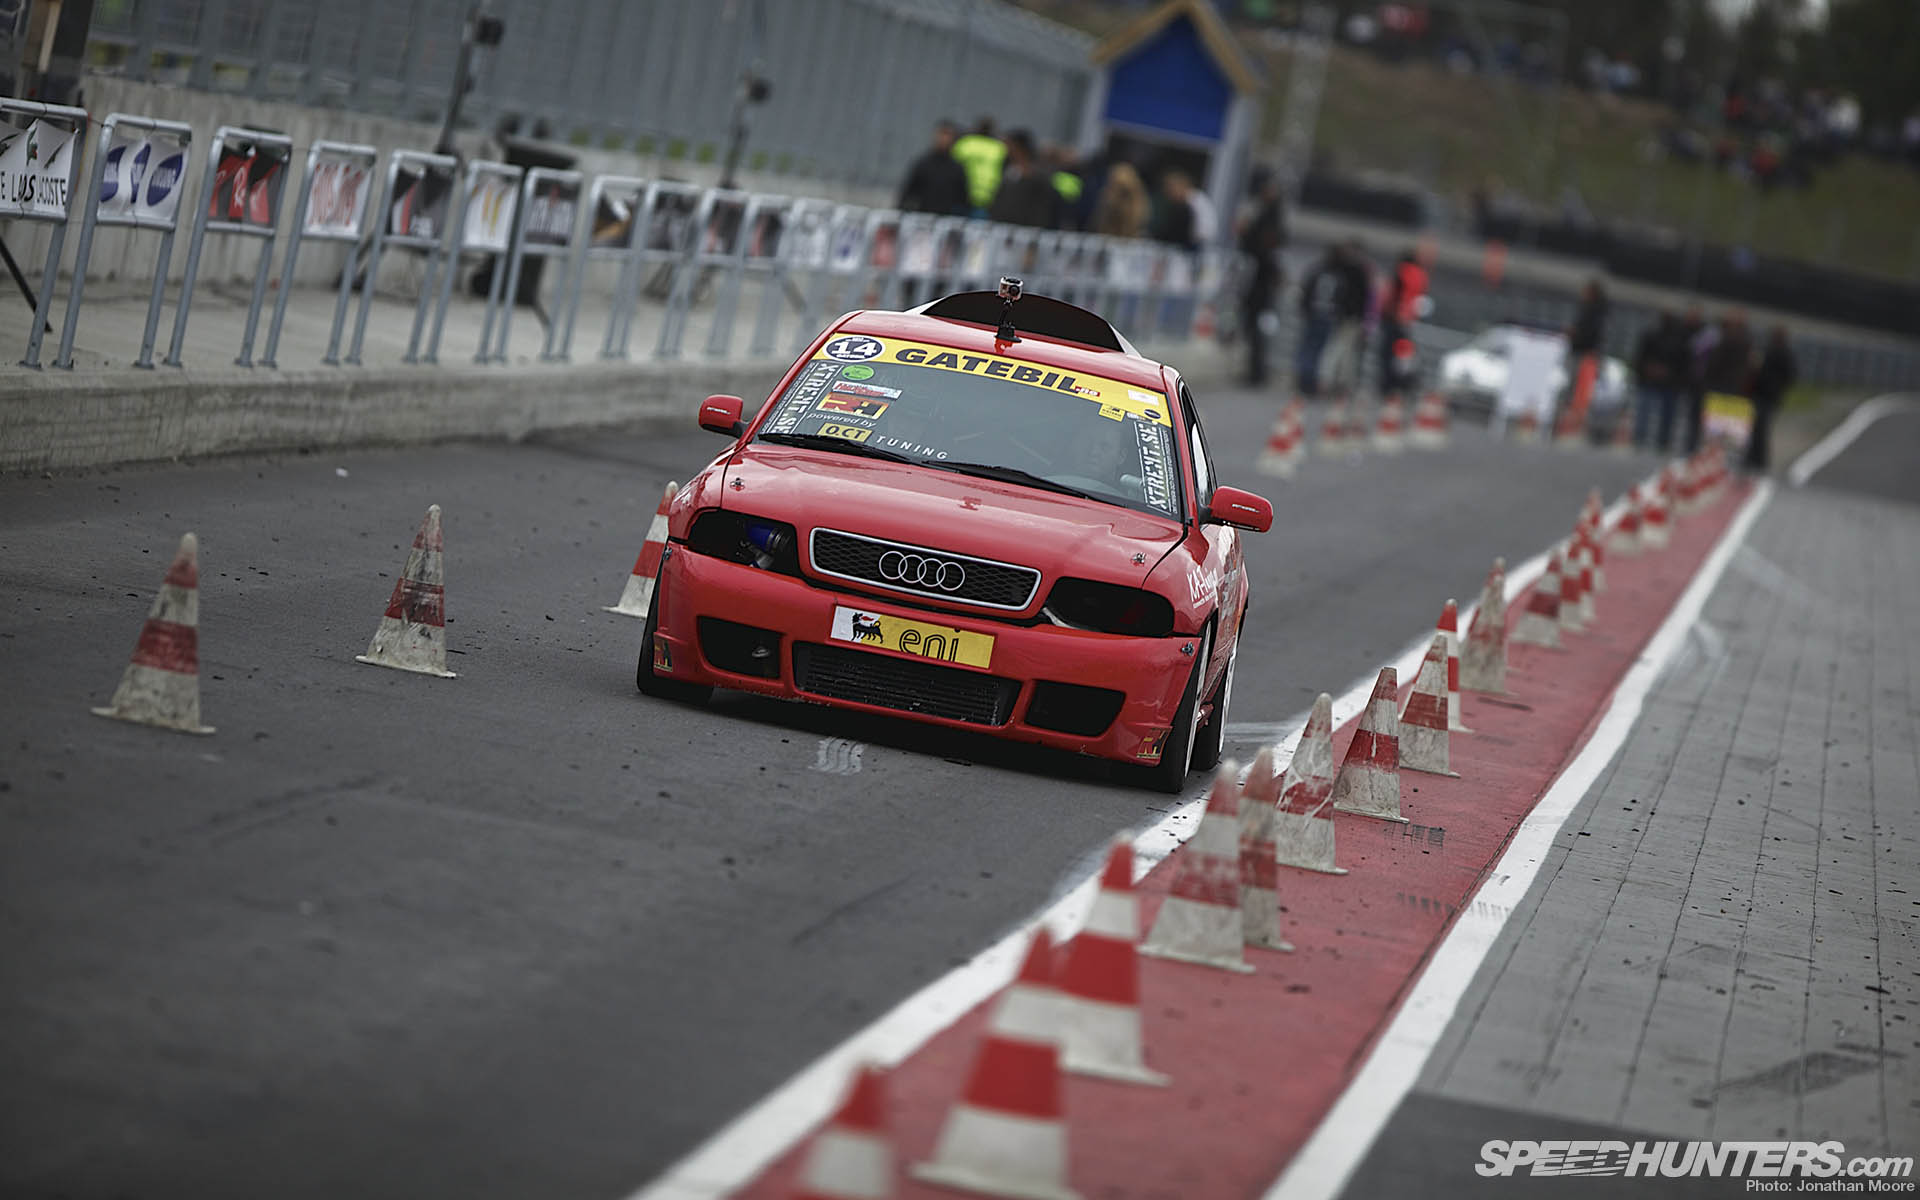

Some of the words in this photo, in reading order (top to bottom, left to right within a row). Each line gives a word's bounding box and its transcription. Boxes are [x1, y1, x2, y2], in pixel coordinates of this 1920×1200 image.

[831, 341, 877, 356] 14
[807, 412, 861, 424] powered
[860, 419, 877, 428] by
[825, 425, 866, 439] O.CT
[876, 435, 948, 460] TUNING
[899, 628, 960, 662] eni
